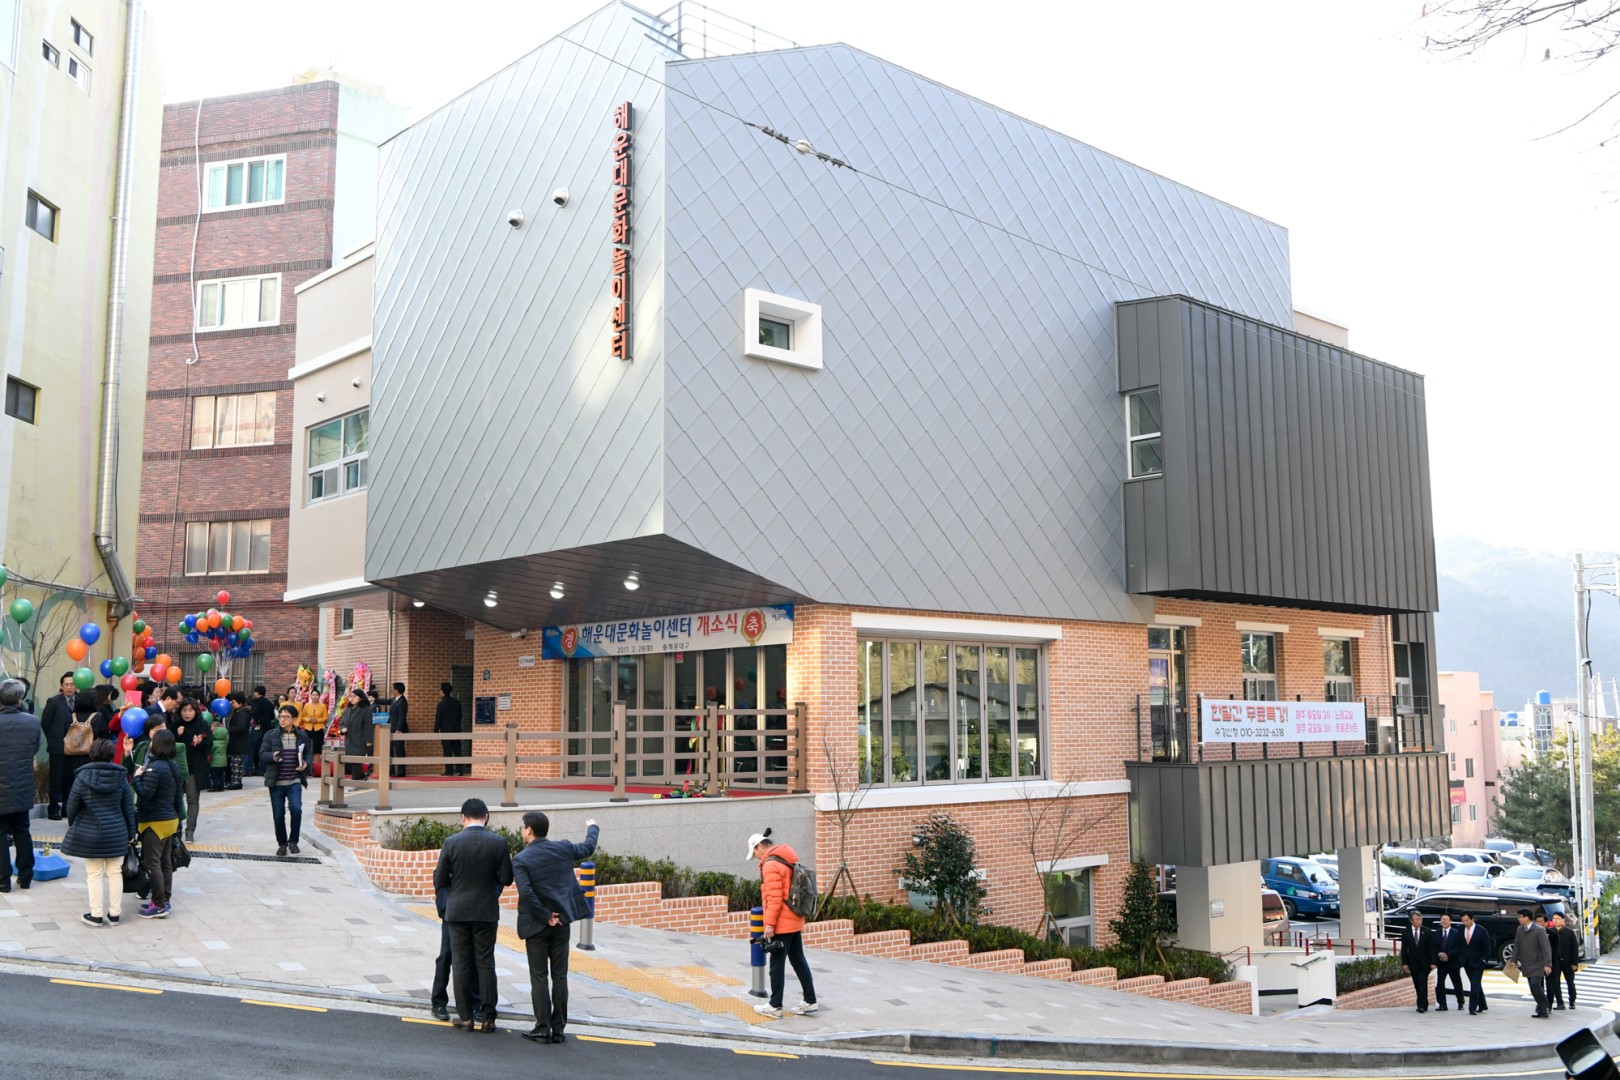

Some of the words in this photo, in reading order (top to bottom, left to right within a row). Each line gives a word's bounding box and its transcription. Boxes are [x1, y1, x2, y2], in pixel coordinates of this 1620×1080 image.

[611, 101, 631, 360] 해운대문화놀이센터
[564, 631, 575, 649] 경
[581, 616, 692, 643] 해운대문화놀이센터
[697, 612, 738, 637] 개소식
[746, 615, 760, 635] 축
[668, 642, 690, 651] 해운대구
[1210, 704, 1243, 722] 한달간
[1246, 705, 1289, 723] 무료특강!
[1215, 727, 1238, 737] 수강신청
